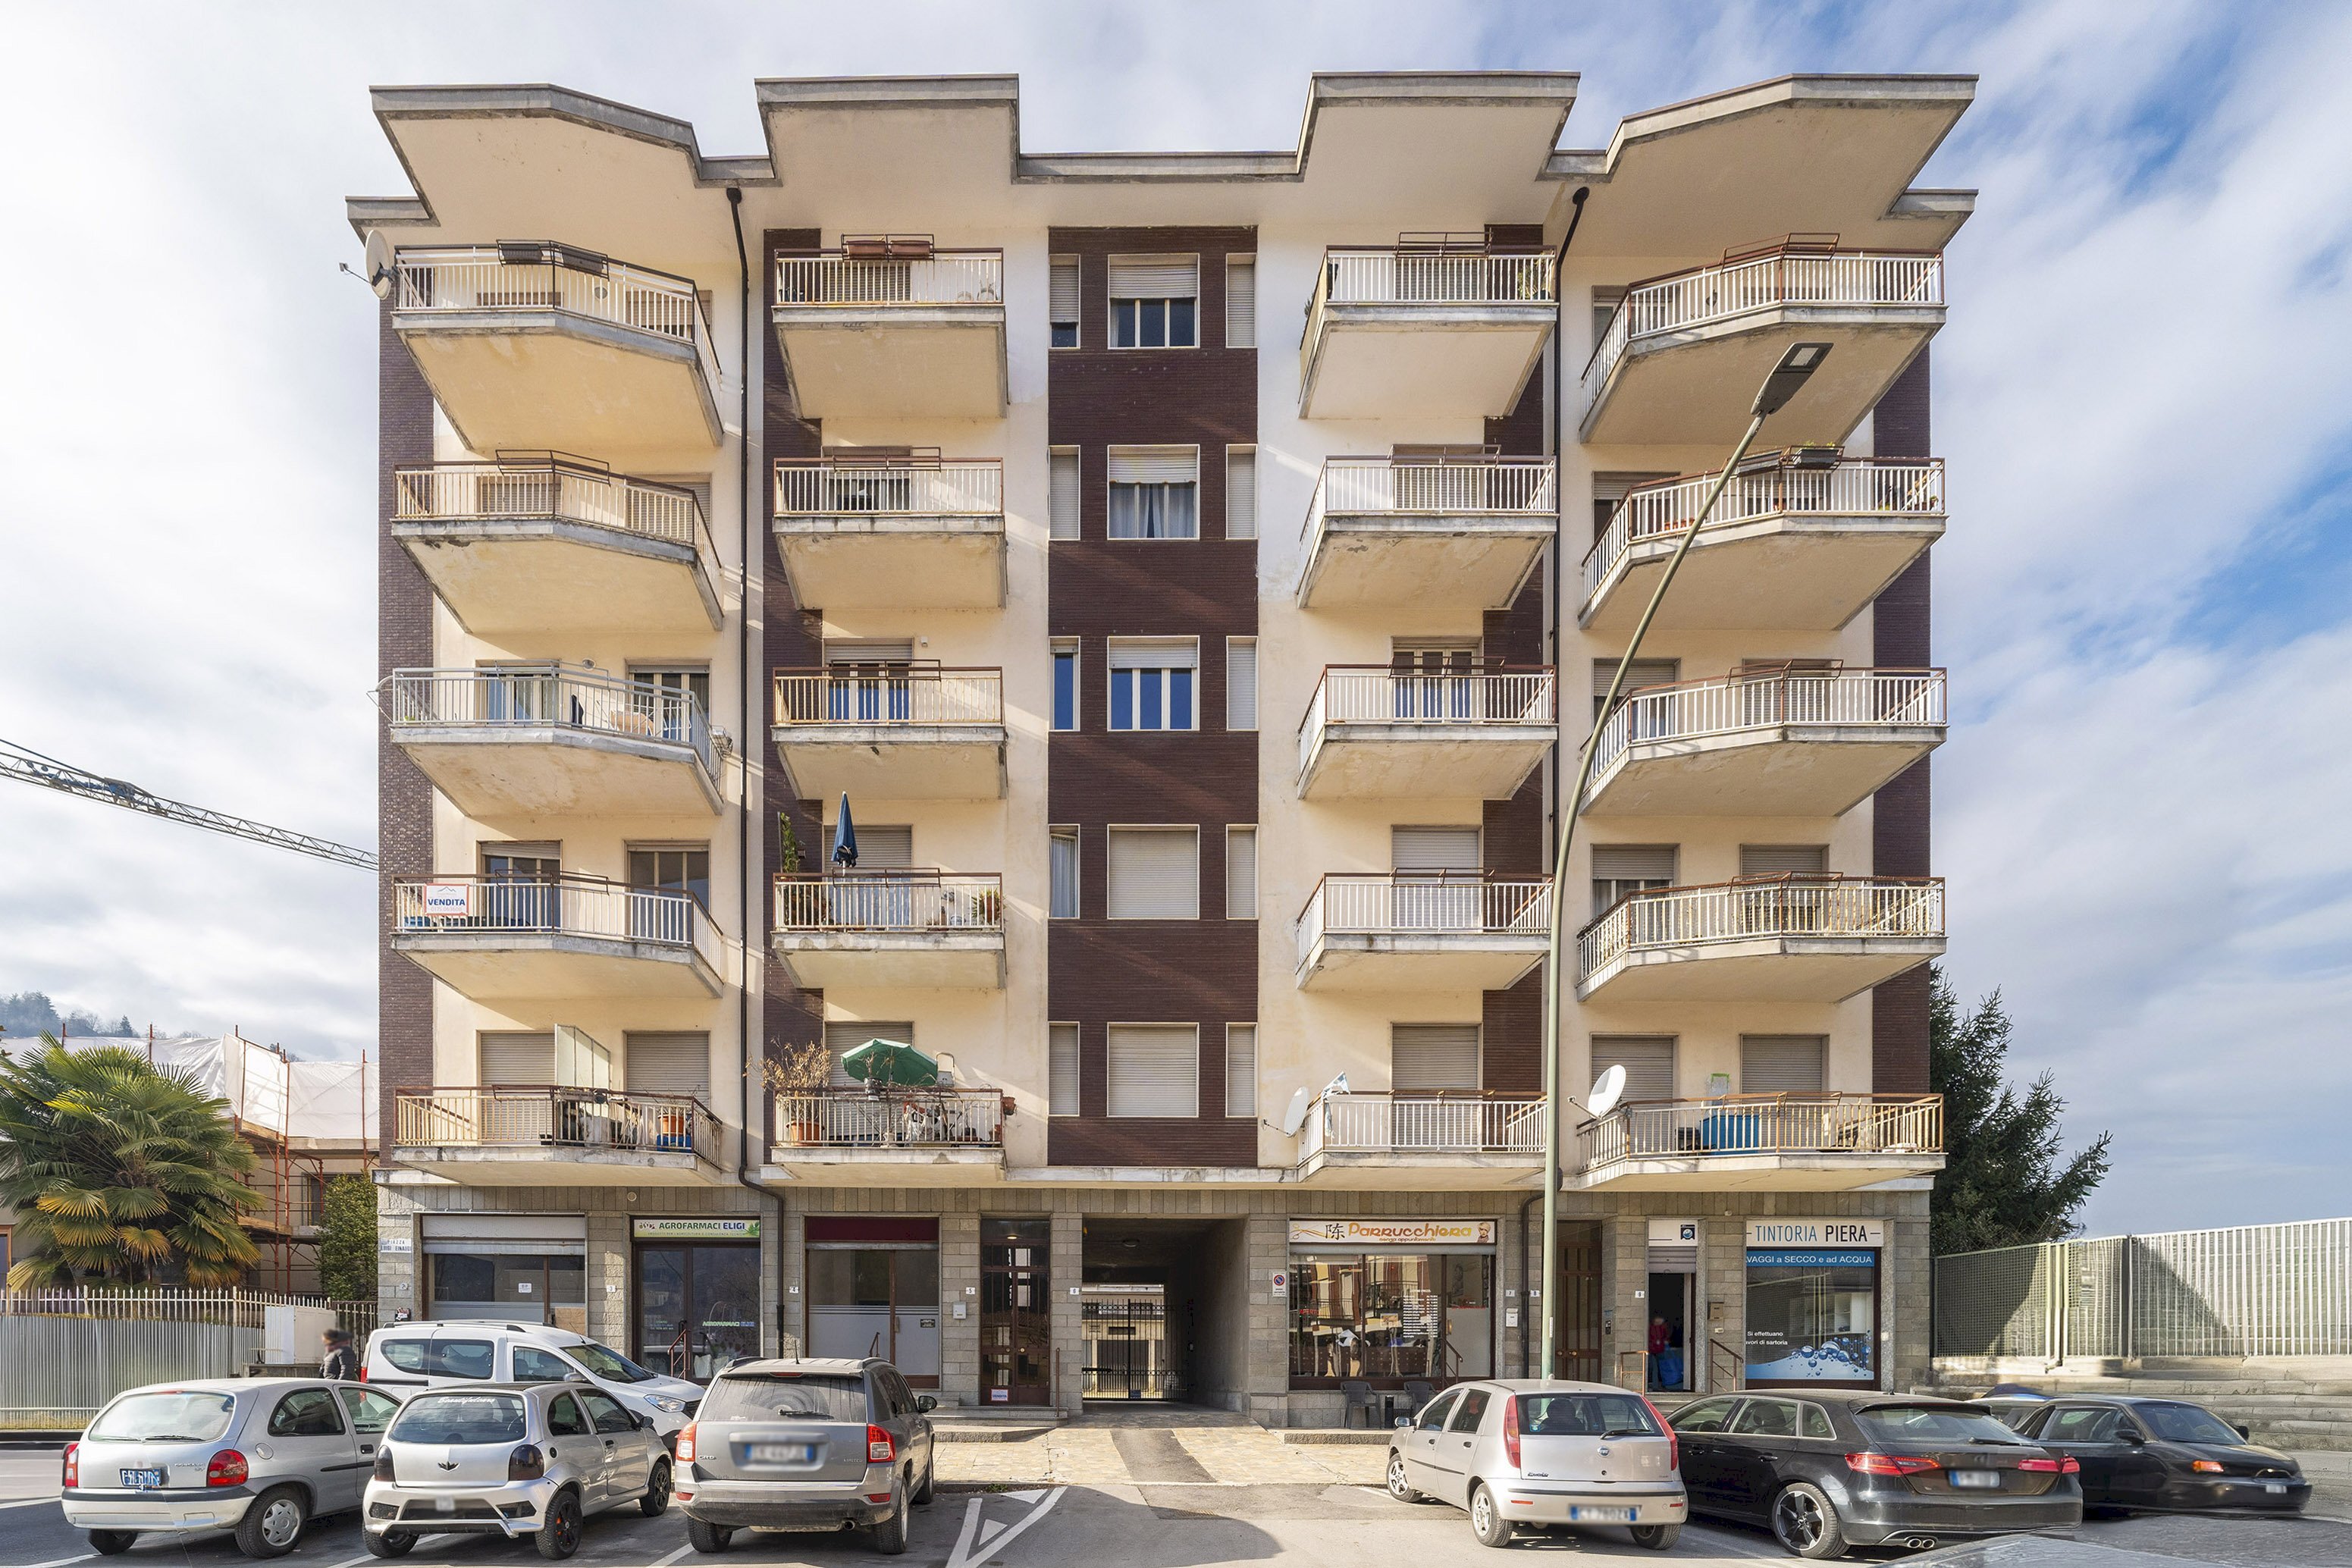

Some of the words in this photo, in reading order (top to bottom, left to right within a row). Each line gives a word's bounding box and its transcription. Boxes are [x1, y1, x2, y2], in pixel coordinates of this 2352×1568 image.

[1325, 1222, 1345, 1240] 陈
[1755, 1225, 1817, 1242] TINTORIA
[1825, 1225, 1867, 1242] PIERA
